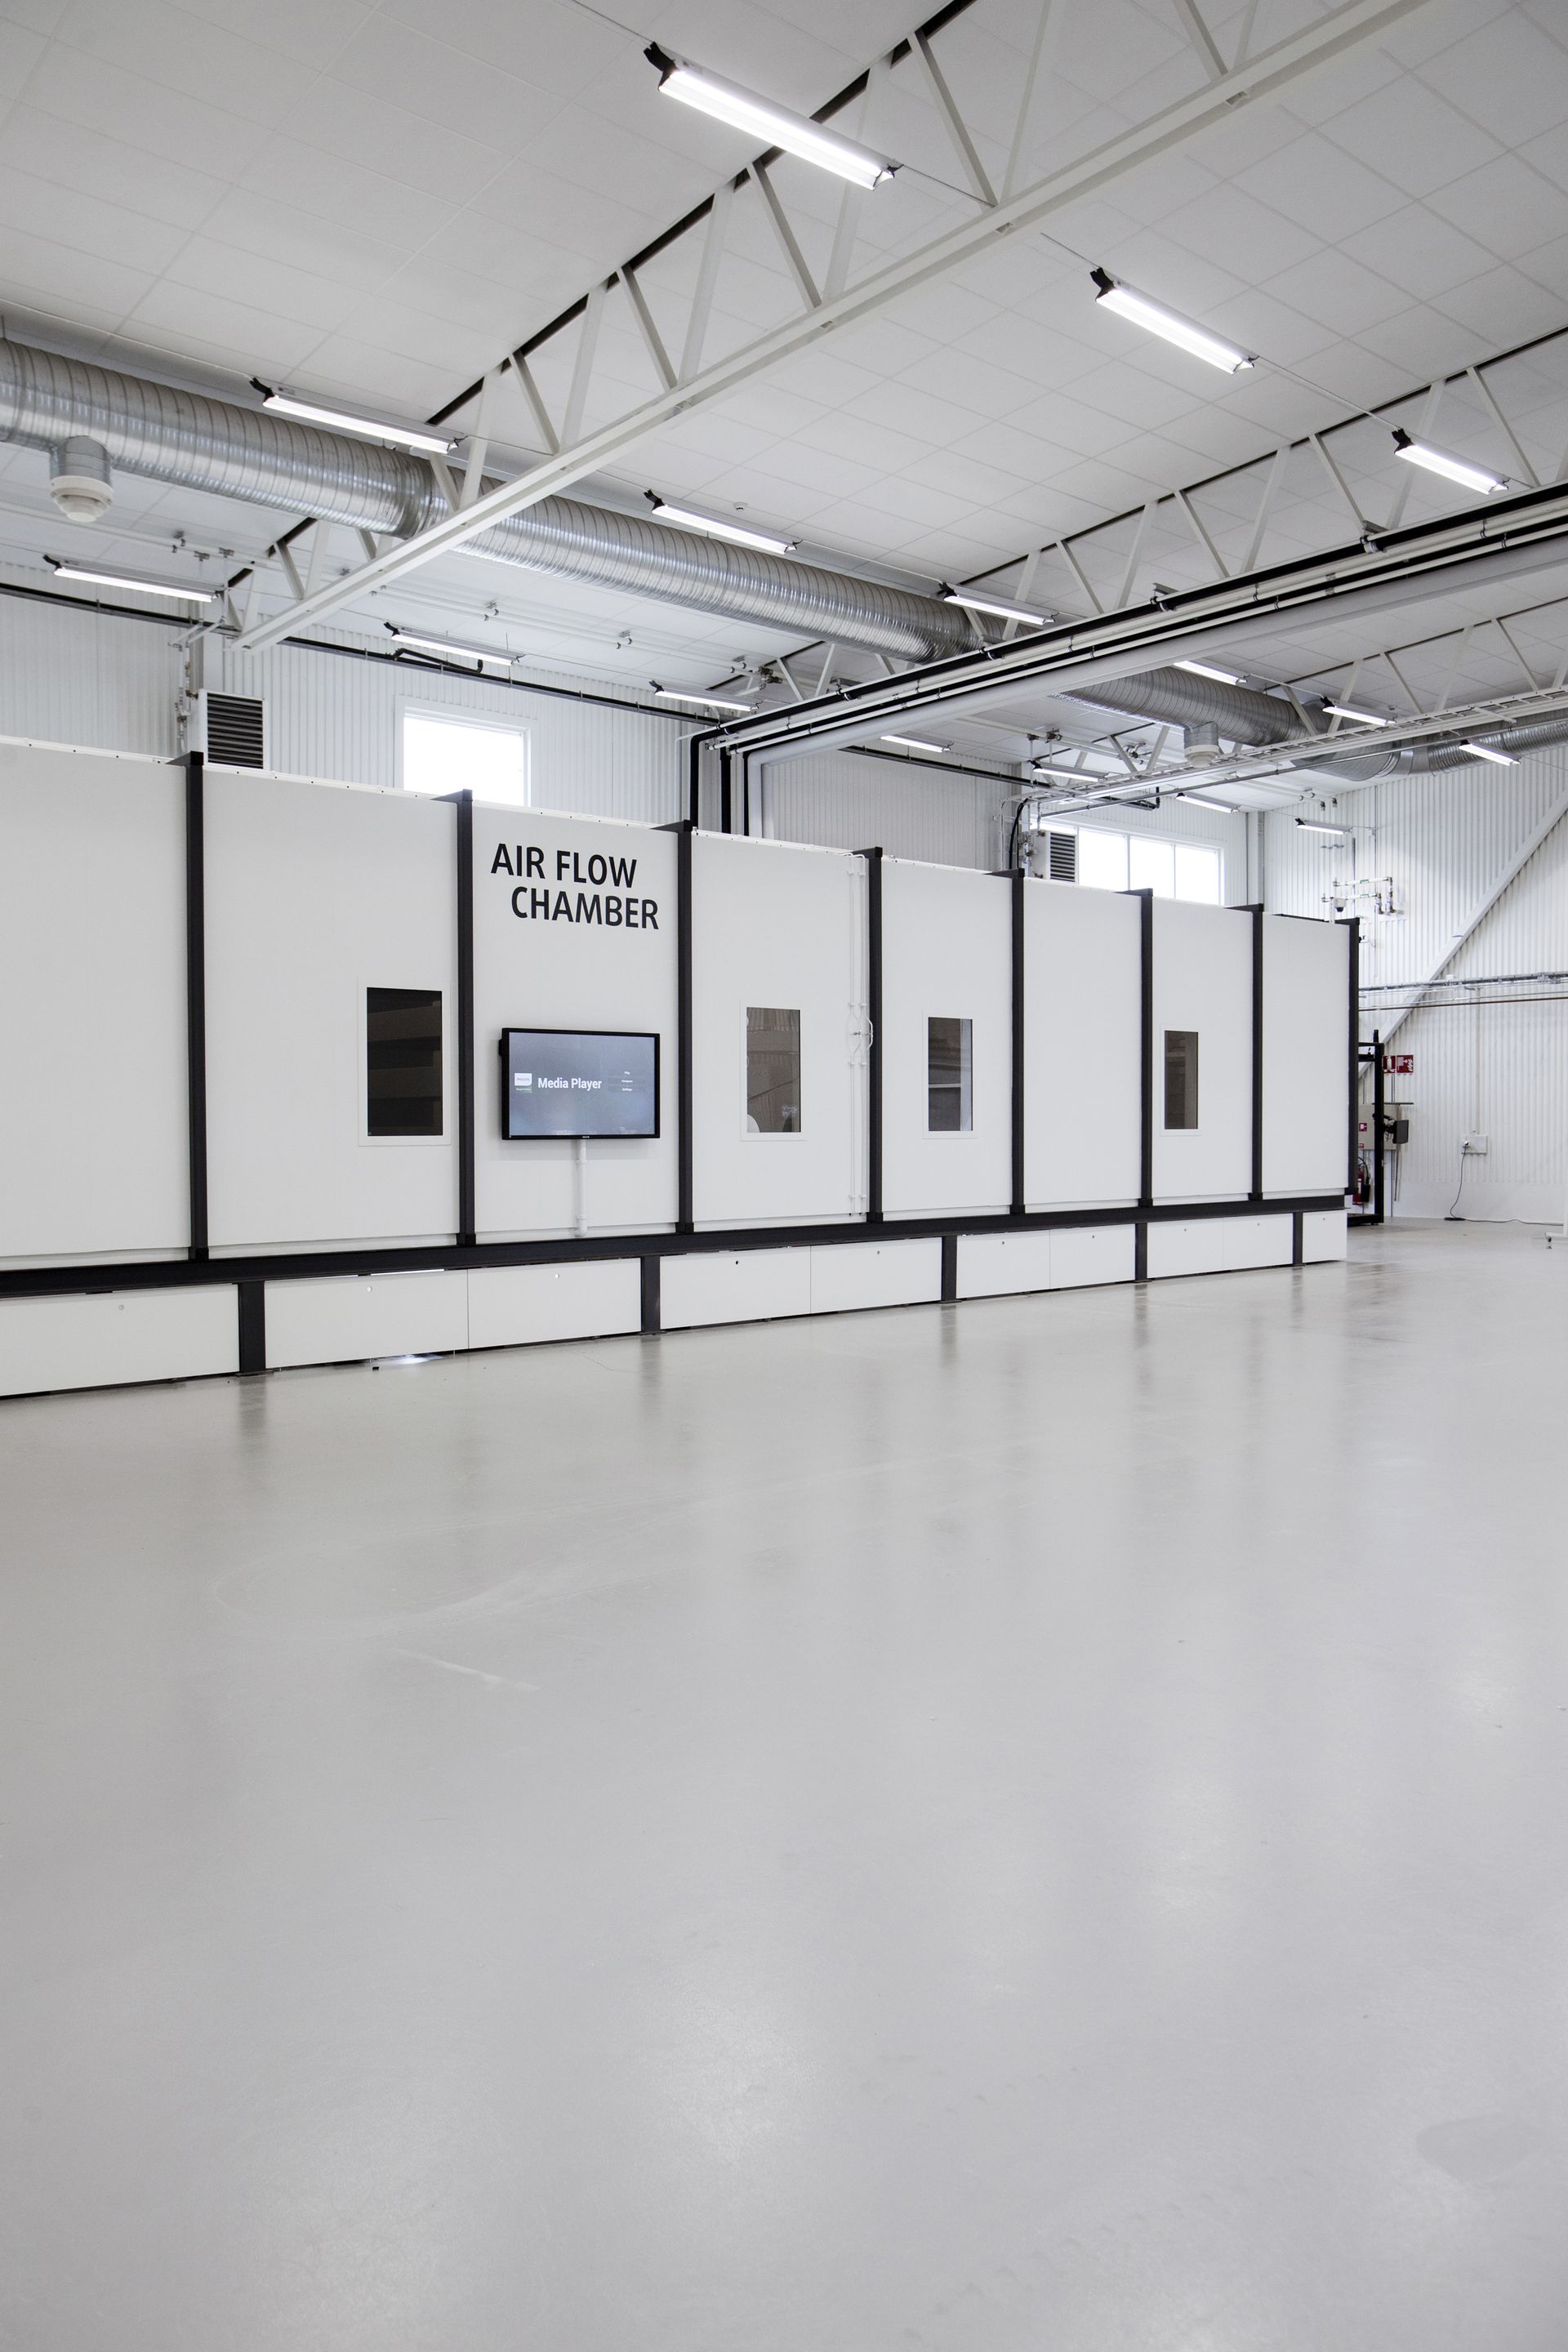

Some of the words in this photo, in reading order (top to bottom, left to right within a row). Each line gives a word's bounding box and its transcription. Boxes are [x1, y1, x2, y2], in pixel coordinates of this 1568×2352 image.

[491, 843, 546, 880] AIR
[557, 849, 638, 889] FLOW
[511, 886, 659, 930] CHAMBER
[537, 1077, 569, 1089] Media
[571, 1077, 603, 1092] Player
